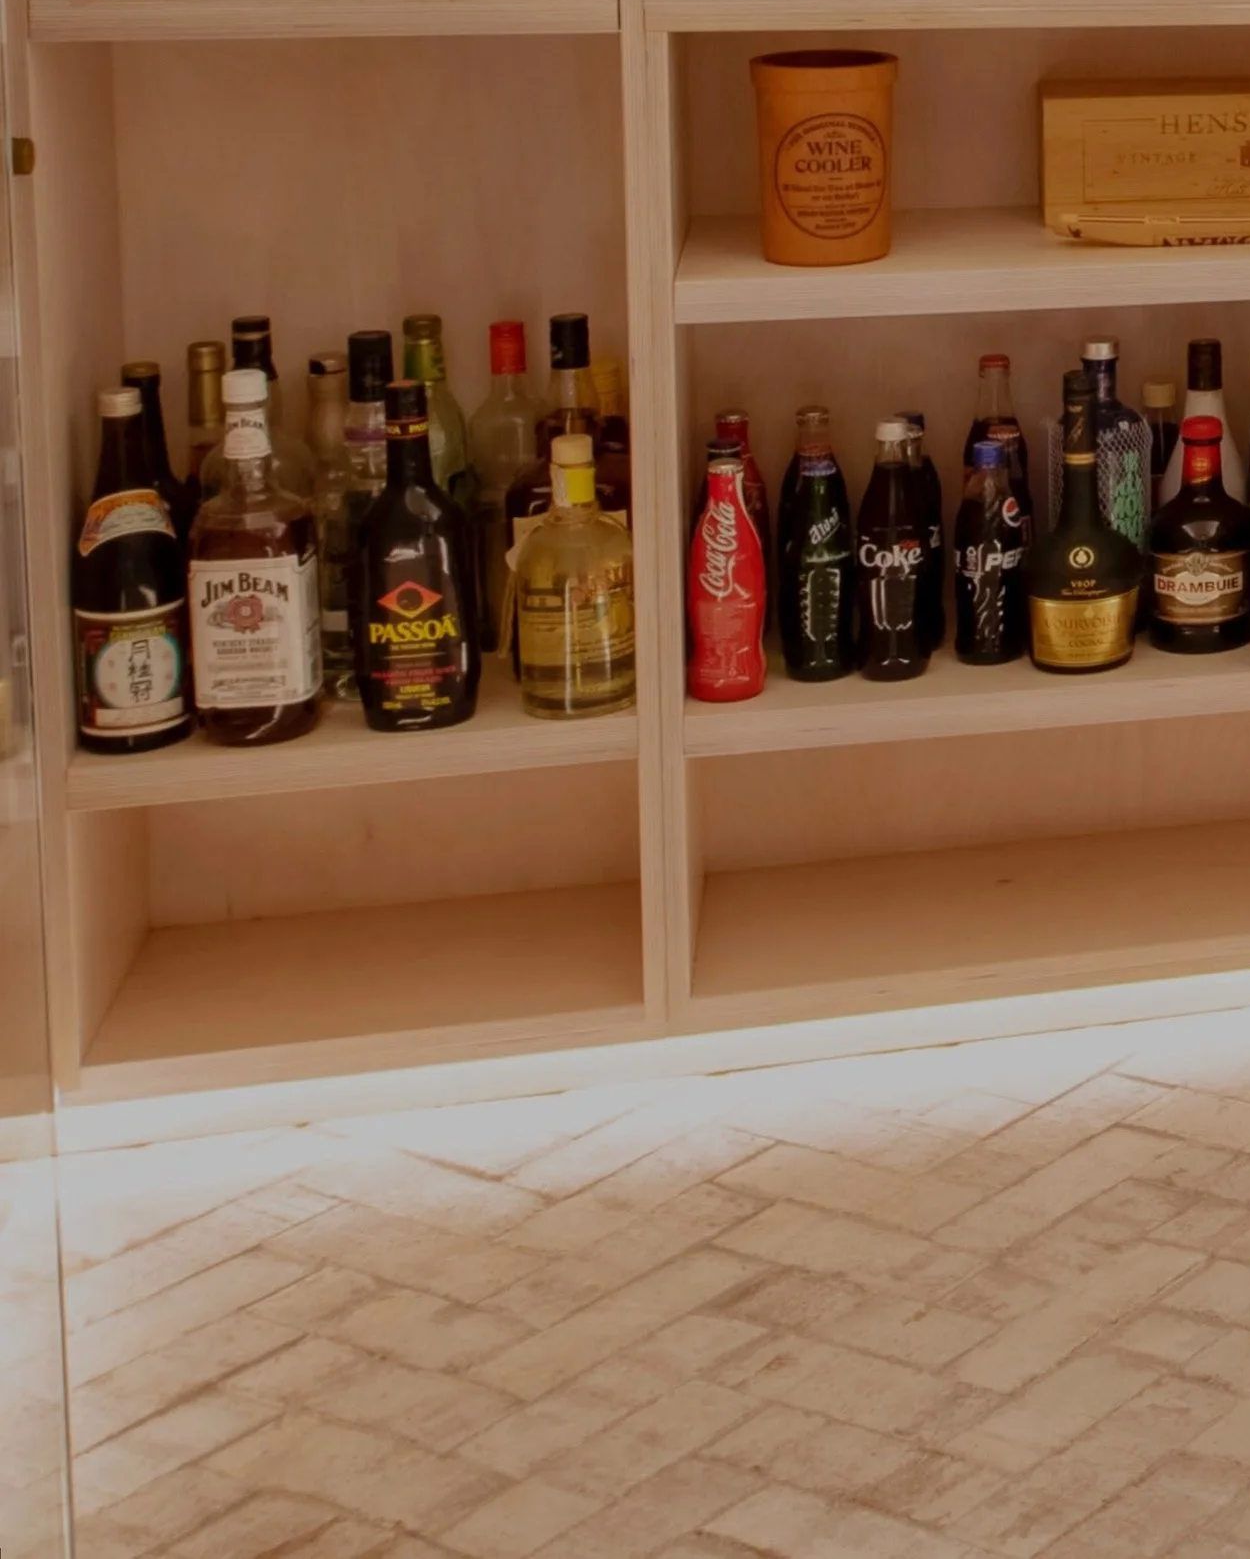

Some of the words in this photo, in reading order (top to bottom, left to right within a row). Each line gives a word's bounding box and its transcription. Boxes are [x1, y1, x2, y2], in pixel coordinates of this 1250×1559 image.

[807, 139, 862, 156] WINE
[794, 155, 873, 173] COOLER
[699, 500, 738, 598] Coca-Cola
[858, 543, 924, 574] Coke
[200, 577, 235, 609] JIM
[238, 571, 289, 603] BEAM
[1157, 576, 1240, 593] DRAMBUIE
